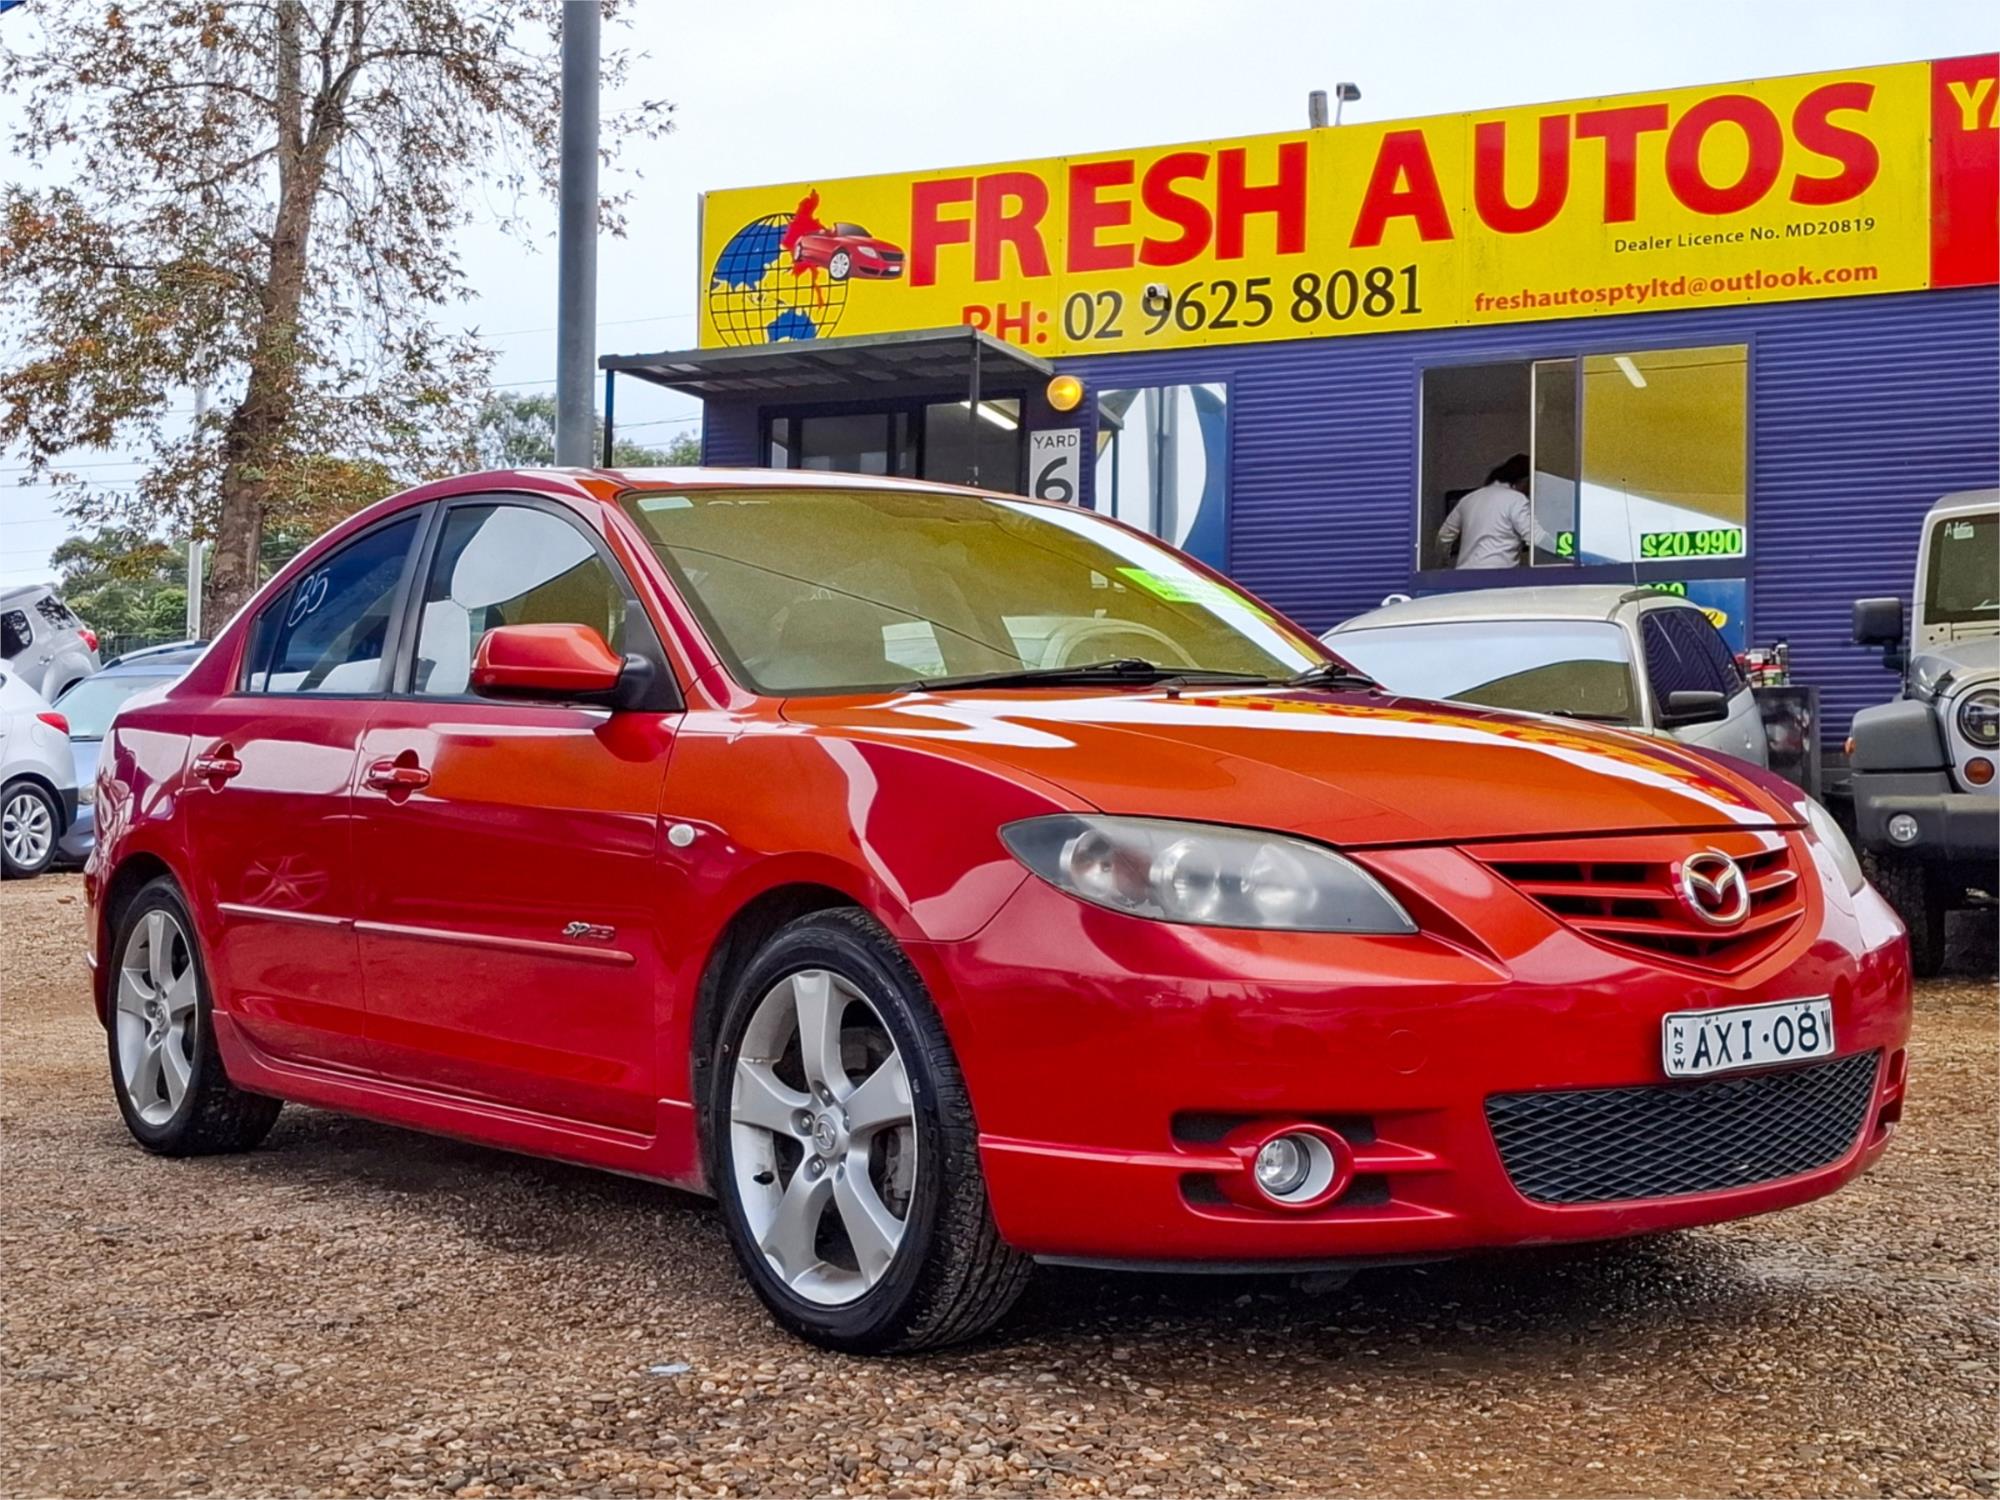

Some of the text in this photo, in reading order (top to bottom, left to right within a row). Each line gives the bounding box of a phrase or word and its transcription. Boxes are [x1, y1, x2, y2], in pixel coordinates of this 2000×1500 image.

[909, 82, 1879, 286] FRESH AUTOS
[1614, 217, 1875, 253] Dealer Licence No. MD20819
[963, 264, 1422, 344] PH: 02 9625 8081
[1474, 265, 1878, 312] freshautosptyltd@outlook.com
[1033, 434, 1078, 449] YARD
[1035, 456, 1073, 504] 6
